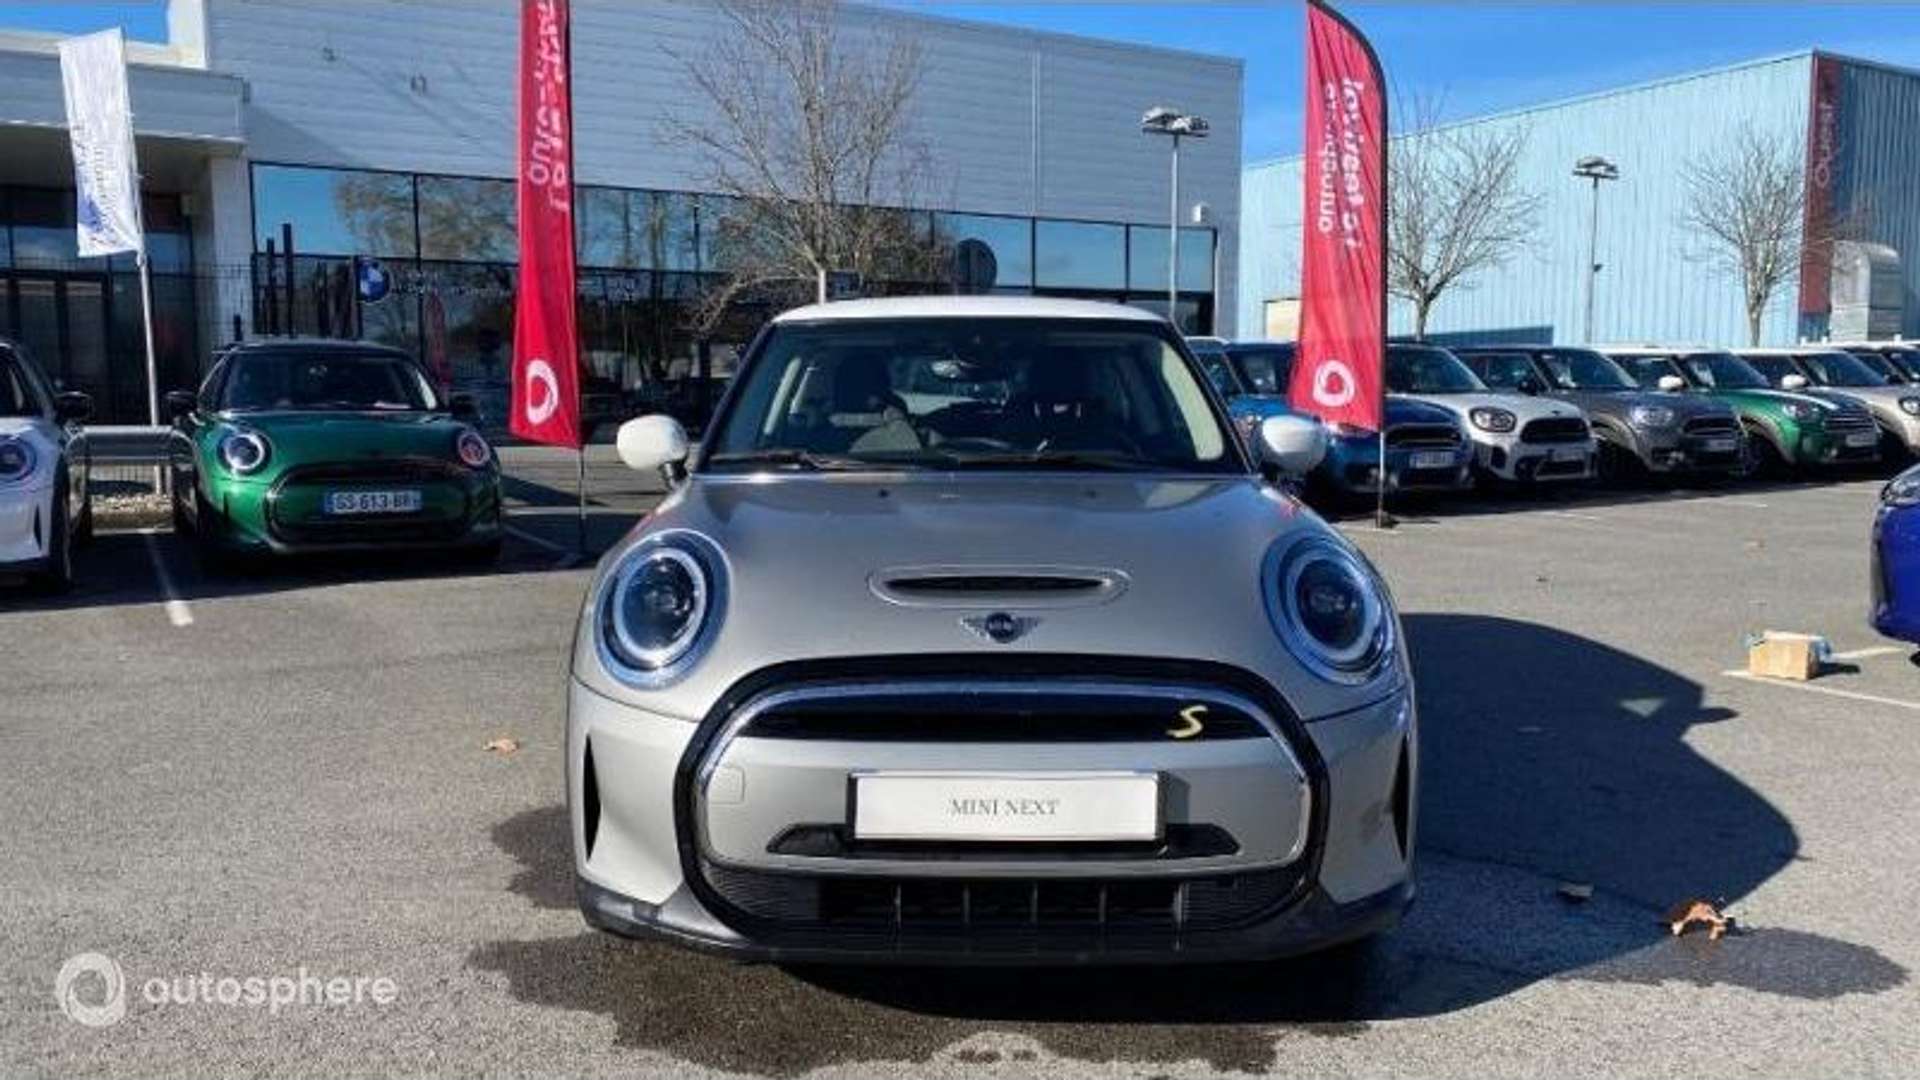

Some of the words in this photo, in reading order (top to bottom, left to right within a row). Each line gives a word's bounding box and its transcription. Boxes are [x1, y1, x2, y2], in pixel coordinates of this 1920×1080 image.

[1165, 704, 1208, 738] S
[947, 799, 997, 815] MINI
[1004, 799, 1060, 815] NEXT
